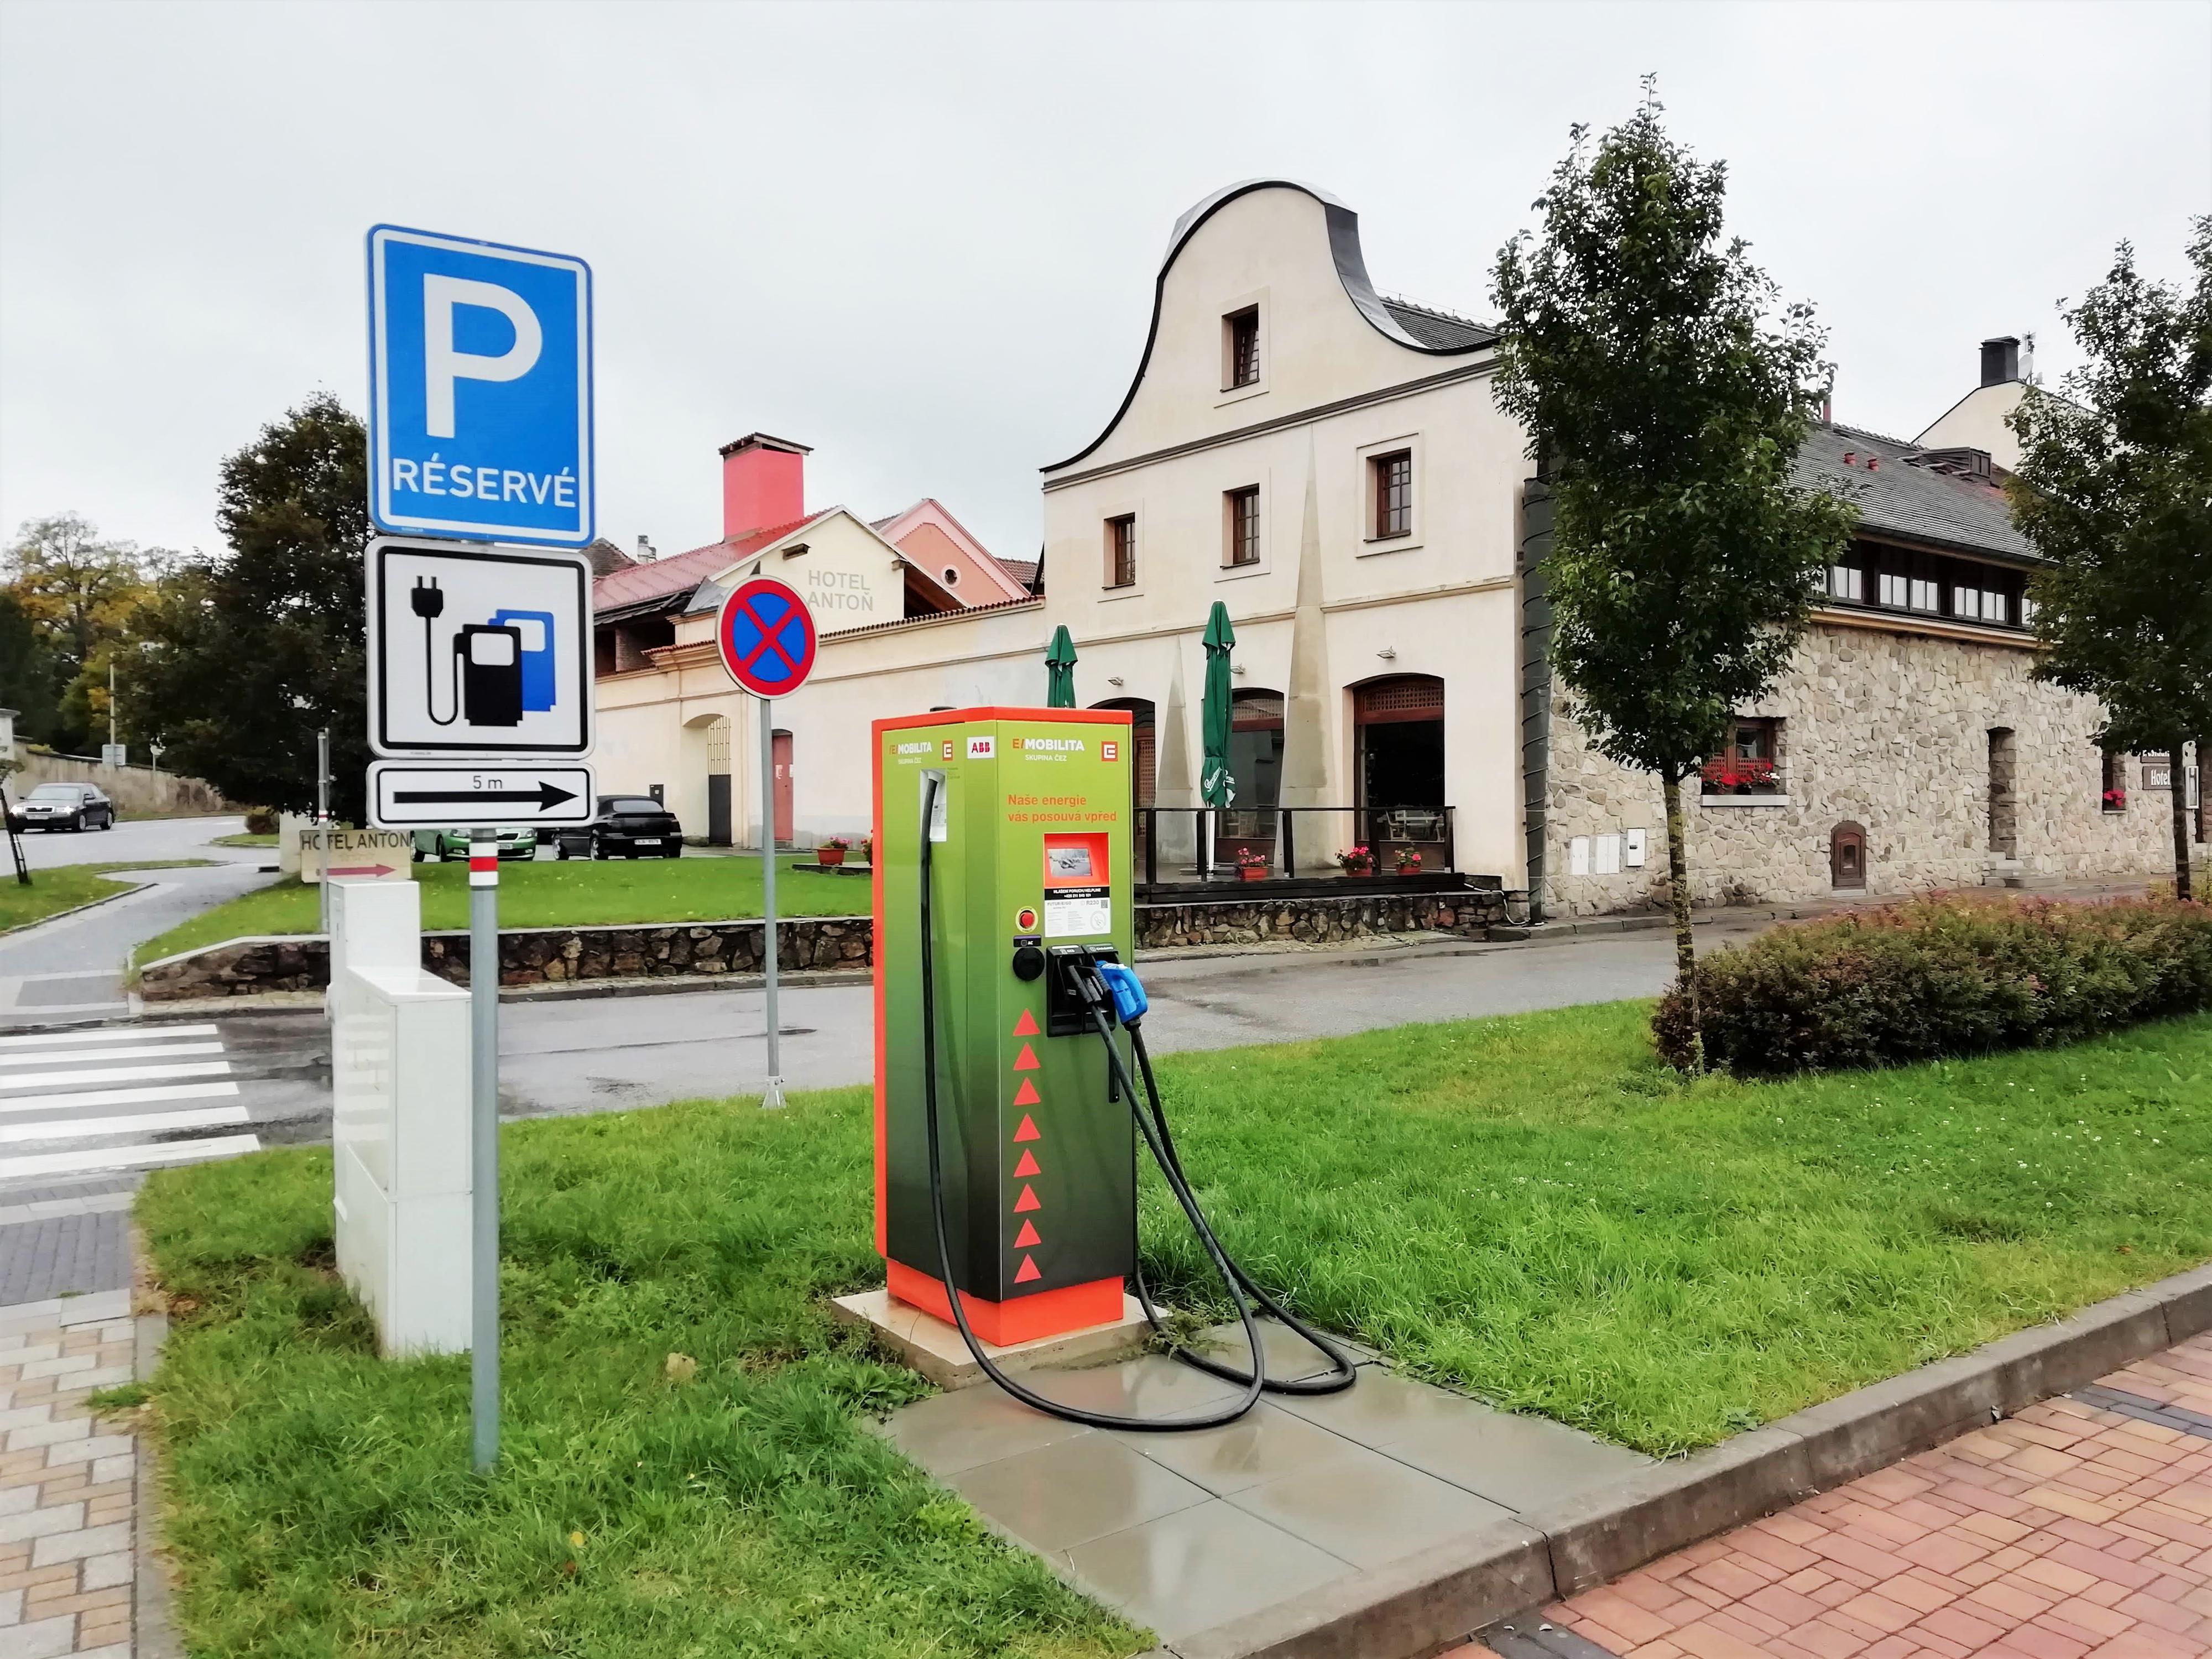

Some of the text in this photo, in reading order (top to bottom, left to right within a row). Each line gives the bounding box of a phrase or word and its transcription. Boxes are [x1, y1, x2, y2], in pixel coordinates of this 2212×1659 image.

[424, 273, 542, 438] P
[393, 452, 576, 507] RÉSERVÉ
[808, 570, 870, 590] HOTEL
[807, 591, 873, 611] ANTOŇ
[972, 742, 990, 753] ABB
[473, 775, 503, 789] 5 m
[2151, 769, 2171, 785] Hotel
[1008, 794, 1087, 807] Naše energie
[1008, 811, 1117, 823] vás posouvá vpřed
